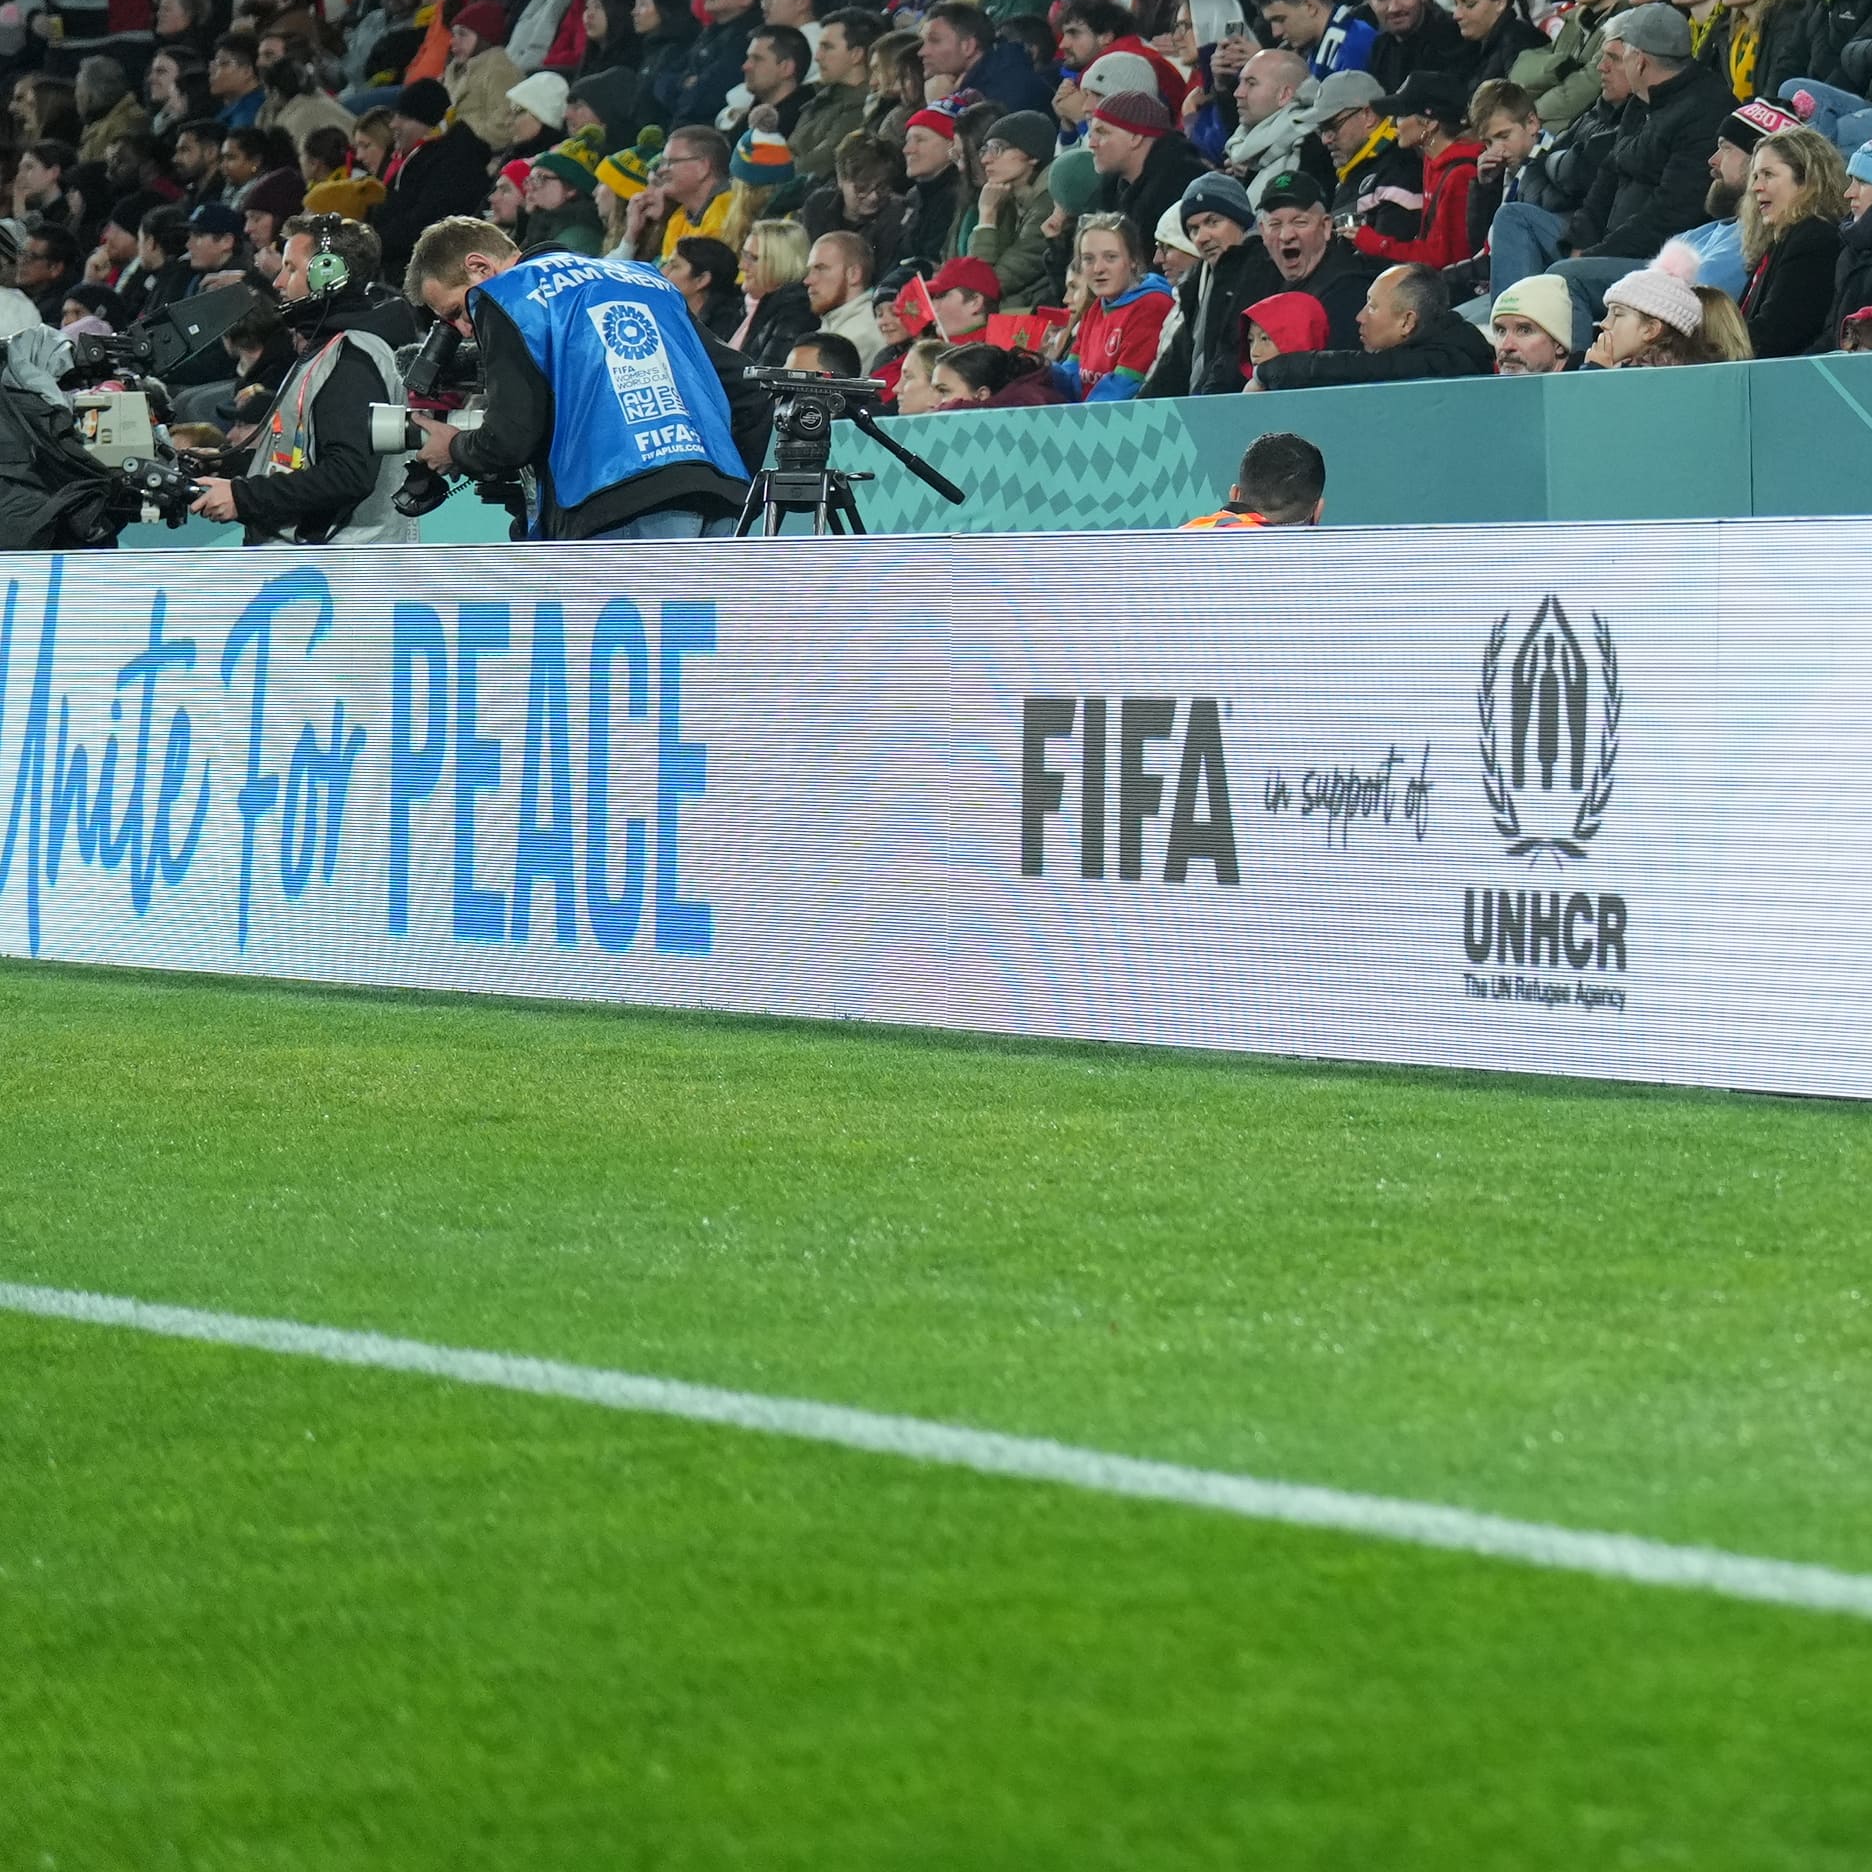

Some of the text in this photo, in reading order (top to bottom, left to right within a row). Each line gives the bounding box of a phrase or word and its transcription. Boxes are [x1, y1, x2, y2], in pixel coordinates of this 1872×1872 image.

[526, 267, 604, 309] TEAM
[613, 365, 635, 376] FIFA
[618, 375, 652, 391] WORLD
[0, 554, 717, 958] Unite For PEACE
[1021, 697, 1432, 886] FIFA in support of
[1464, 889, 1628, 972] UNHCR
[1464, 973, 1626, 1013] The UN Refugee Agency
